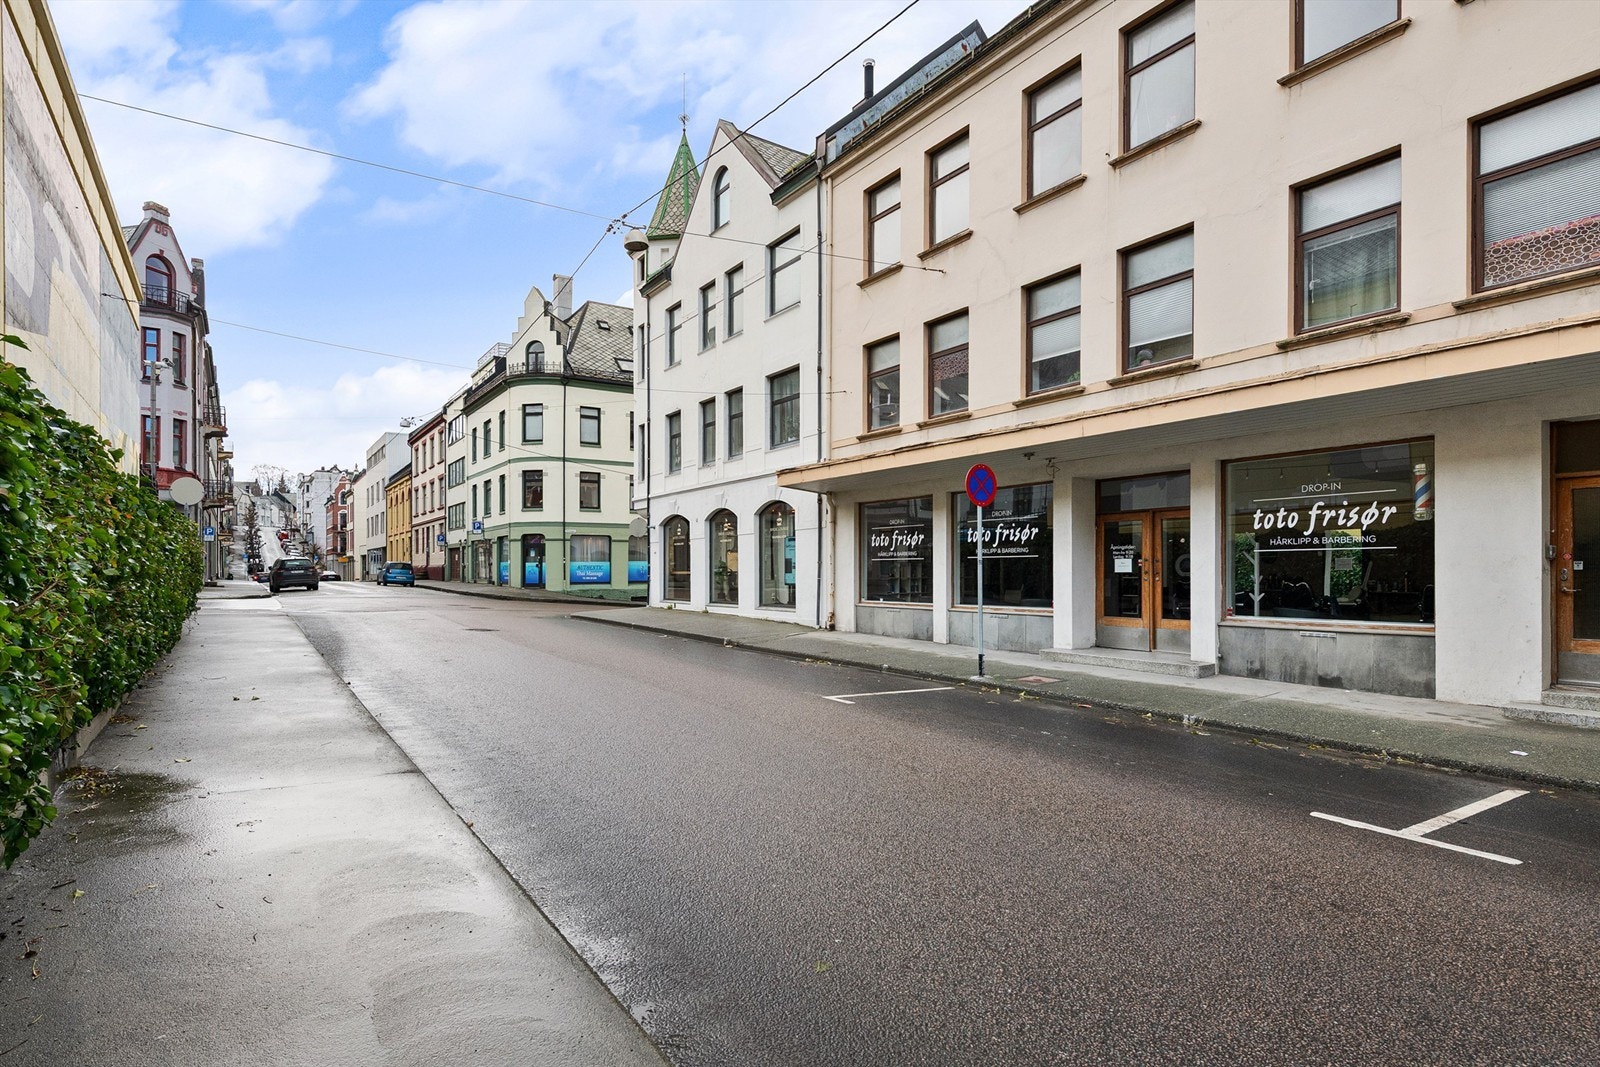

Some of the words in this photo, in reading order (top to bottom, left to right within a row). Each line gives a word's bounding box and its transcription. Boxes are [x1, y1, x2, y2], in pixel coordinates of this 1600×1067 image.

[1301, 482, 1342, 493] DROP-IN
[1253, 507, 1299, 530] toto
[1303, 500, 1397, 536] frisør
[871, 533, 889, 547] toto
[890, 530, 925, 551] frisør
[992, 523, 1039, 547] frisør
[1269, 536, 1311, 546] HÅRKLIPP
[1312, 536, 1320, 545] &
[1321, 535, 1377, 545] BARBERING
[1001, 546, 1029, 554] BARBERING
